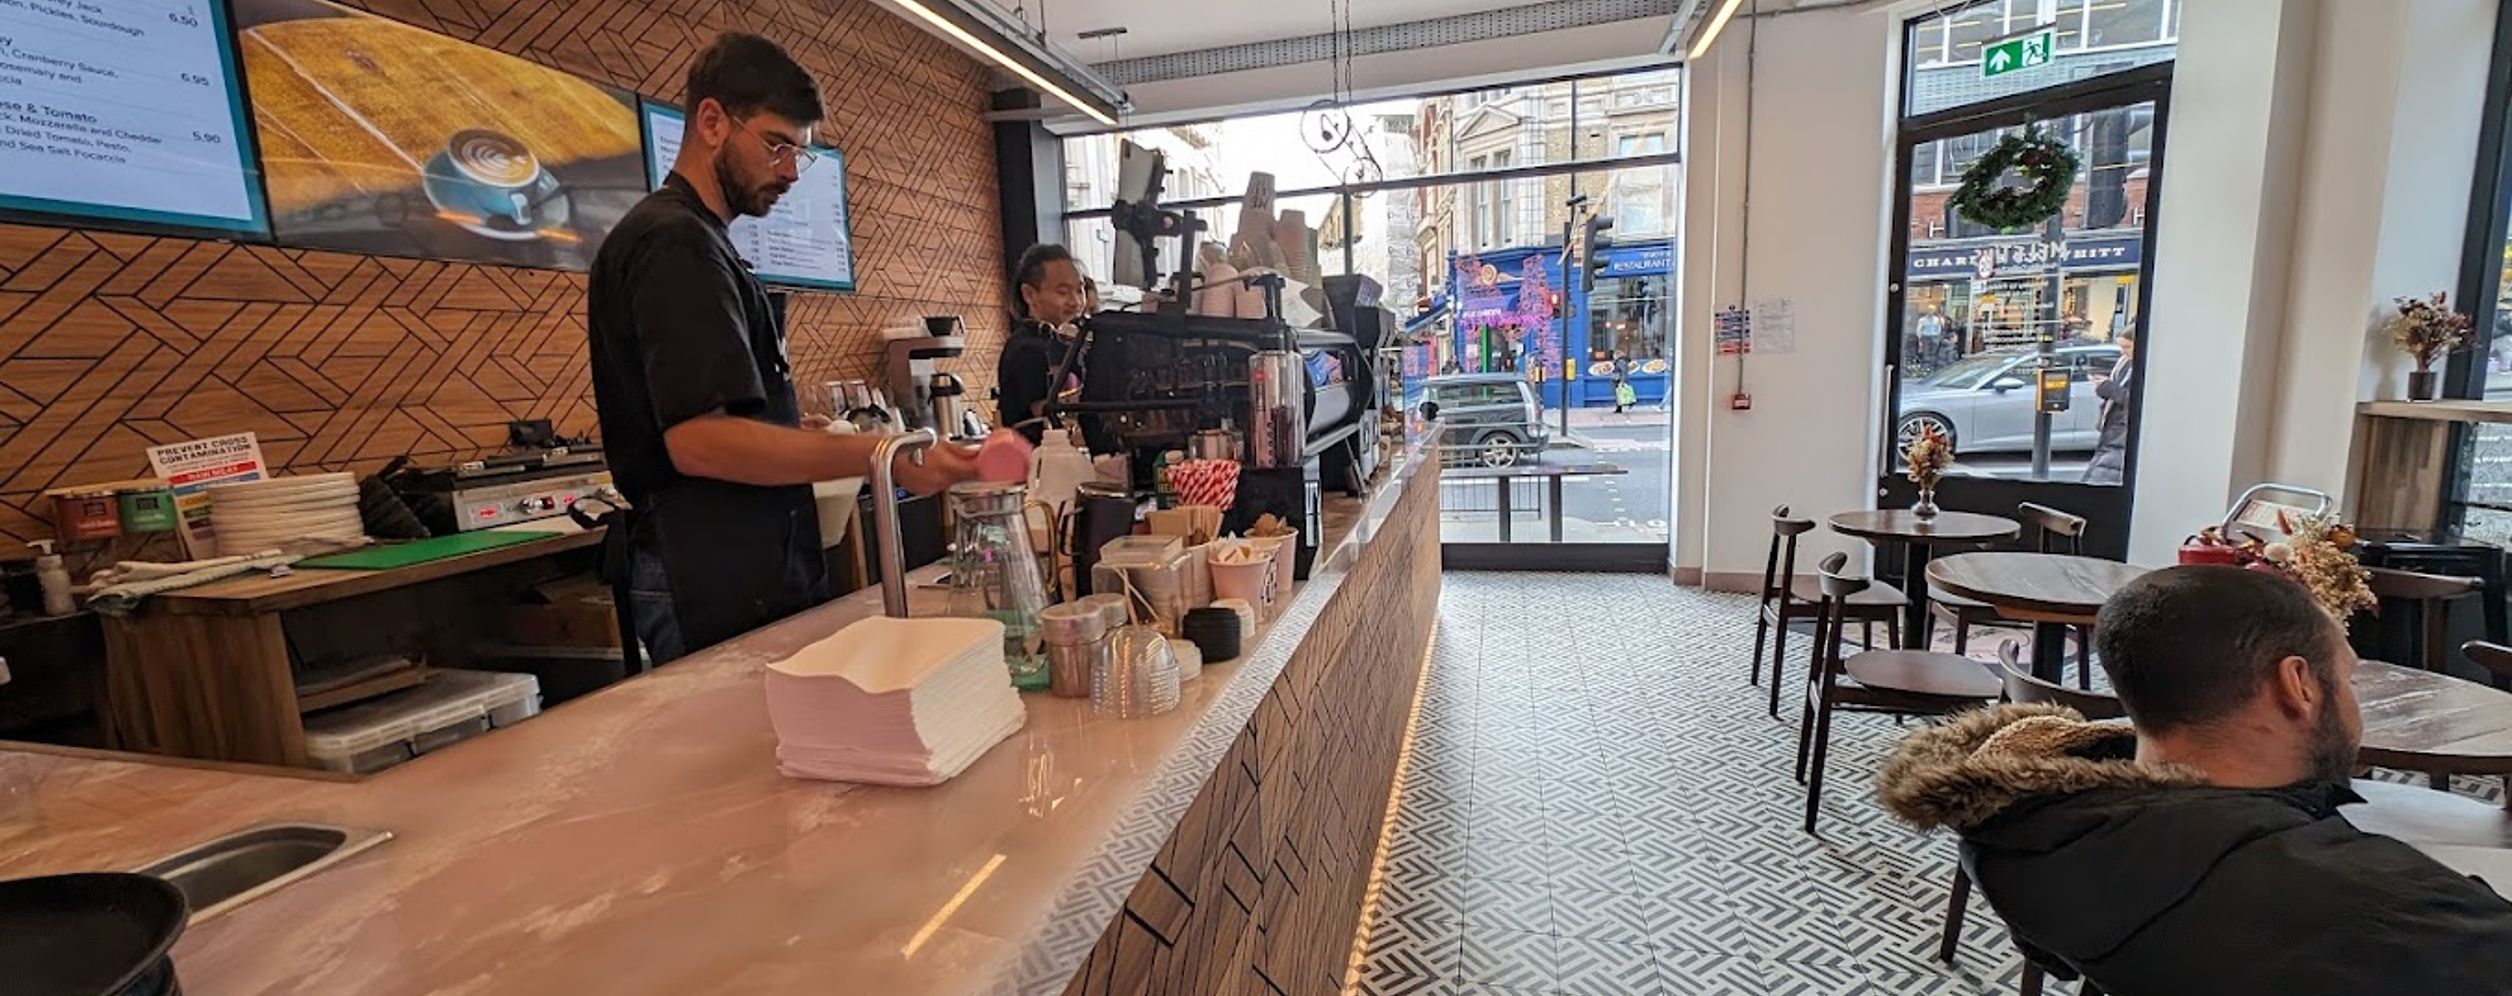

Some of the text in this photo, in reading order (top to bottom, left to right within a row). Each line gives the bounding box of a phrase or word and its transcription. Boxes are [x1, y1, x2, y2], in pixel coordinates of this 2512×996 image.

[80, 14, 145, 37] Sourdough
[168, 12, 199, 28] 6.50
[11, 48, 76, 71] Cranberry
[27, 102, 38, 114] &
[42, 105, 98, 123] Tomato
[114, 129, 163, 144] Cheddar
[192, 130, 221, 144] 5.90
[18, 141, 45, 152] Sea
[74, 149, 127, 164] Focaccia
[156, 435, 249, 457] PREVENT CROSS
[159, 443, 252, 465] CONTAMINATION
